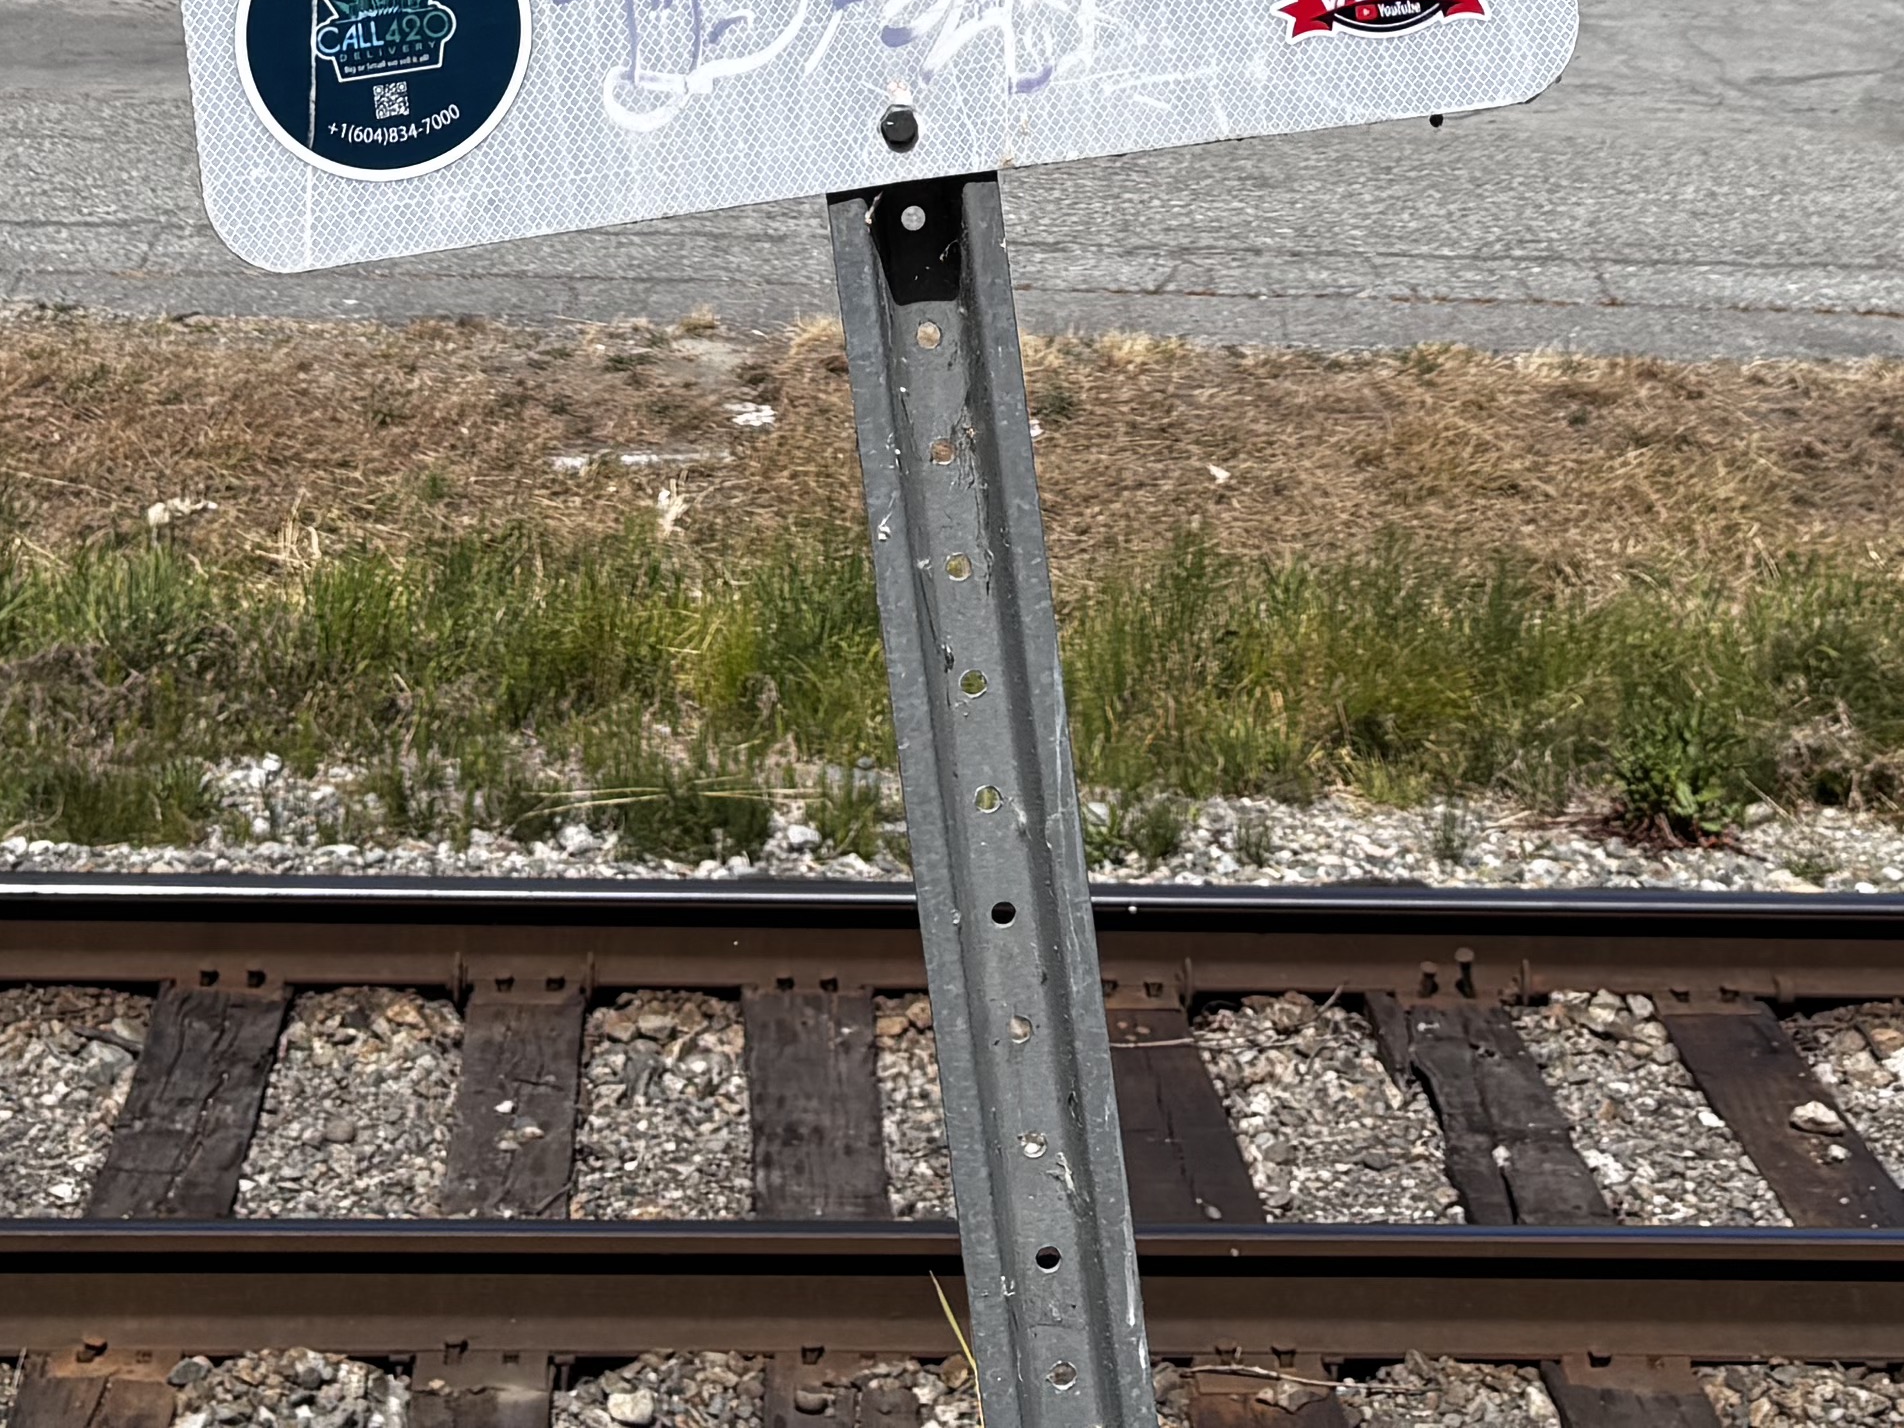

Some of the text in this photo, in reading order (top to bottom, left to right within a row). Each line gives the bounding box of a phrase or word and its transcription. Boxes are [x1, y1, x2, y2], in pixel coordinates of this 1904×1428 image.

[1377, 0, 1422, 18] YouTube
[339, 40, 436, 63] DELIVERY
[327, 103, 461, 146] +1(604)834-7000
